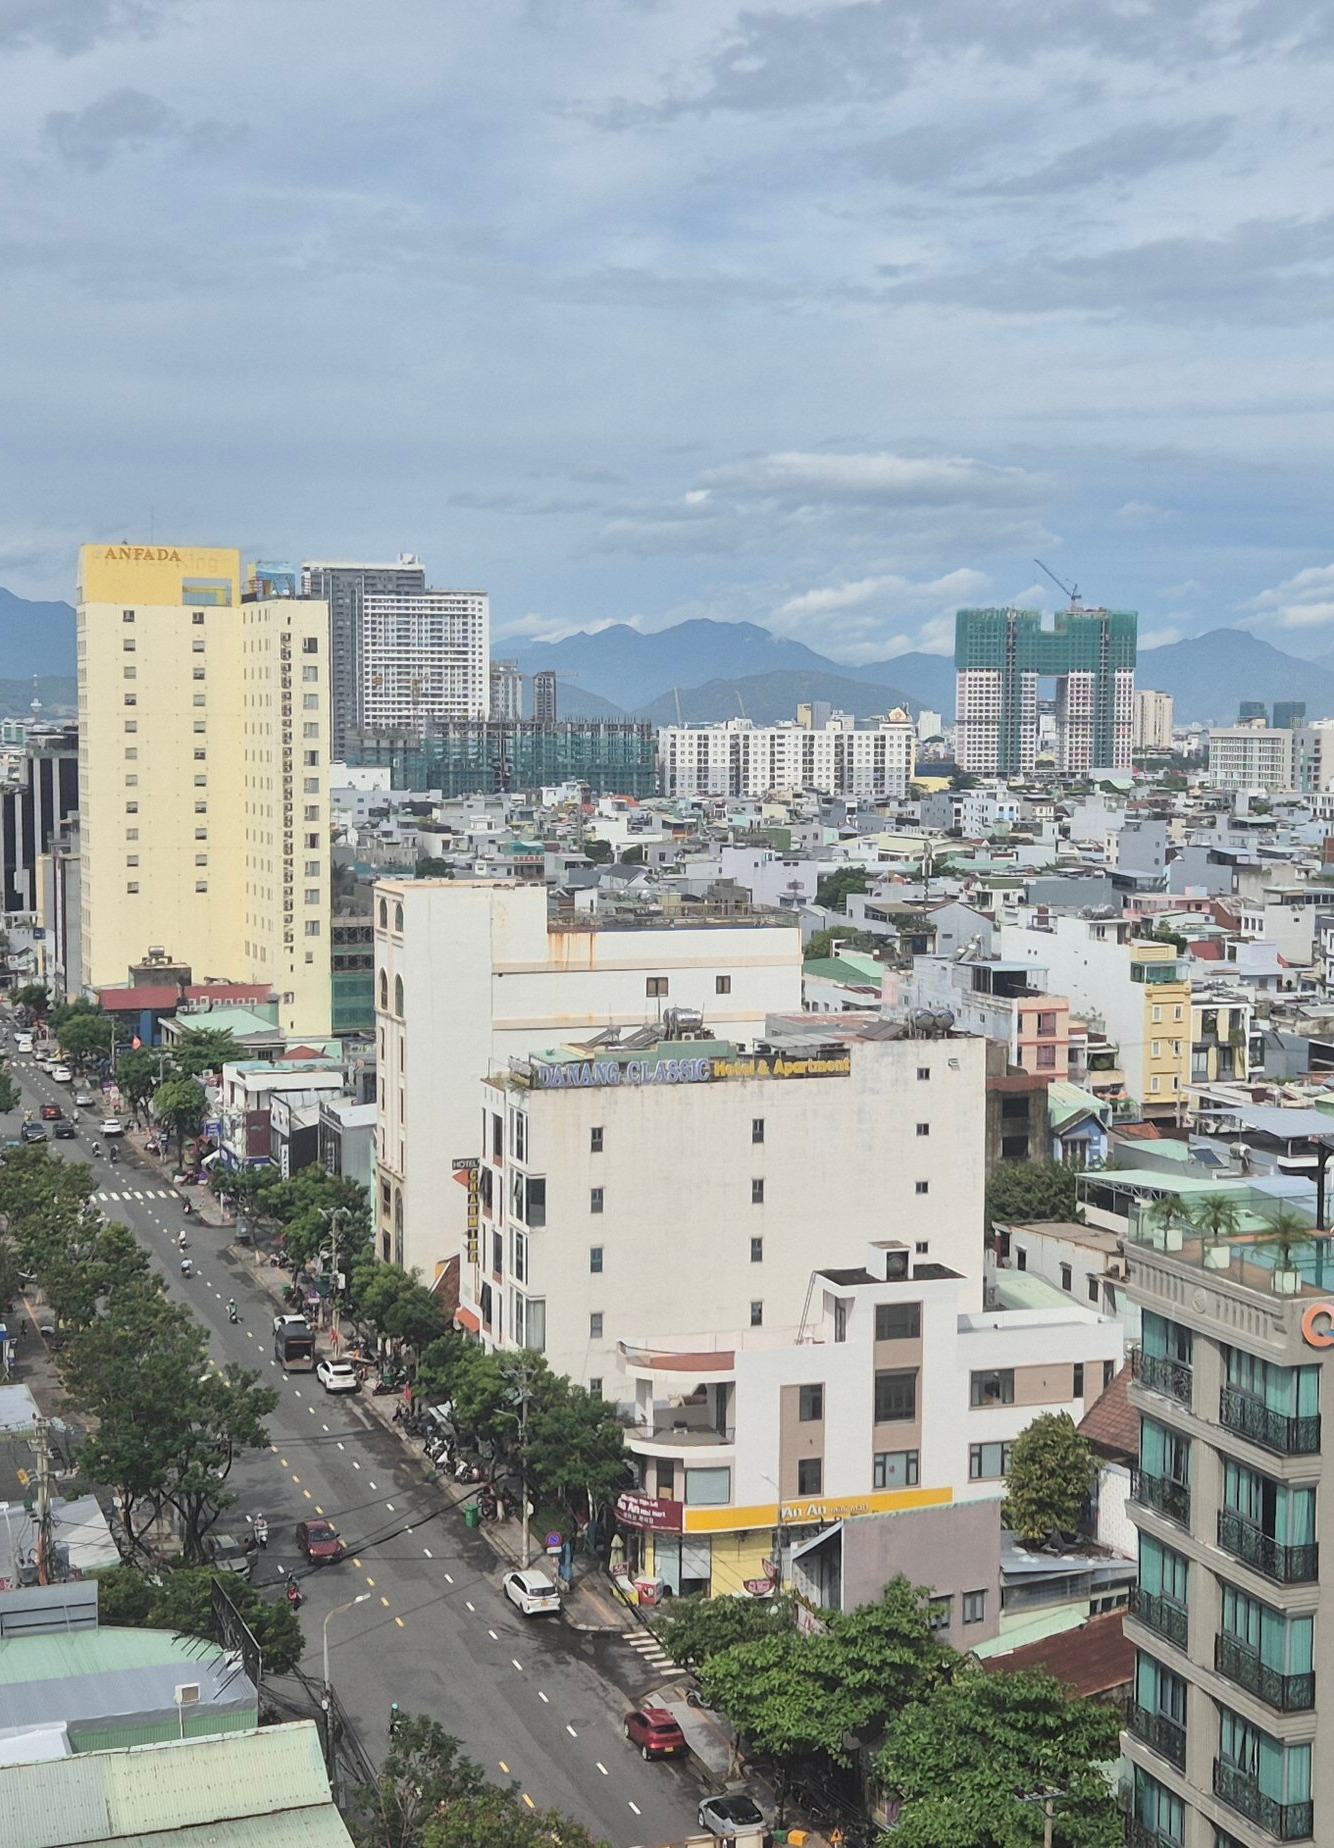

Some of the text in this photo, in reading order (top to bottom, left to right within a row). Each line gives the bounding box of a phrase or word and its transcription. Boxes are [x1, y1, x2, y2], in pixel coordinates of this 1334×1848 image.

[104, 546, 182, 562] ANFADA
[627, 1057, 710, 1084] CLASSIC
[714, 1058, 755, 1077] Hotel
[757, 1058, 770, 1075] &
[773, 1056, 851, 1077] Apartment
[453, 1159, 479, 1169] HOTEL
[782, 1506, 802, 1518] An
[807, 1503, 827, 1516] An
